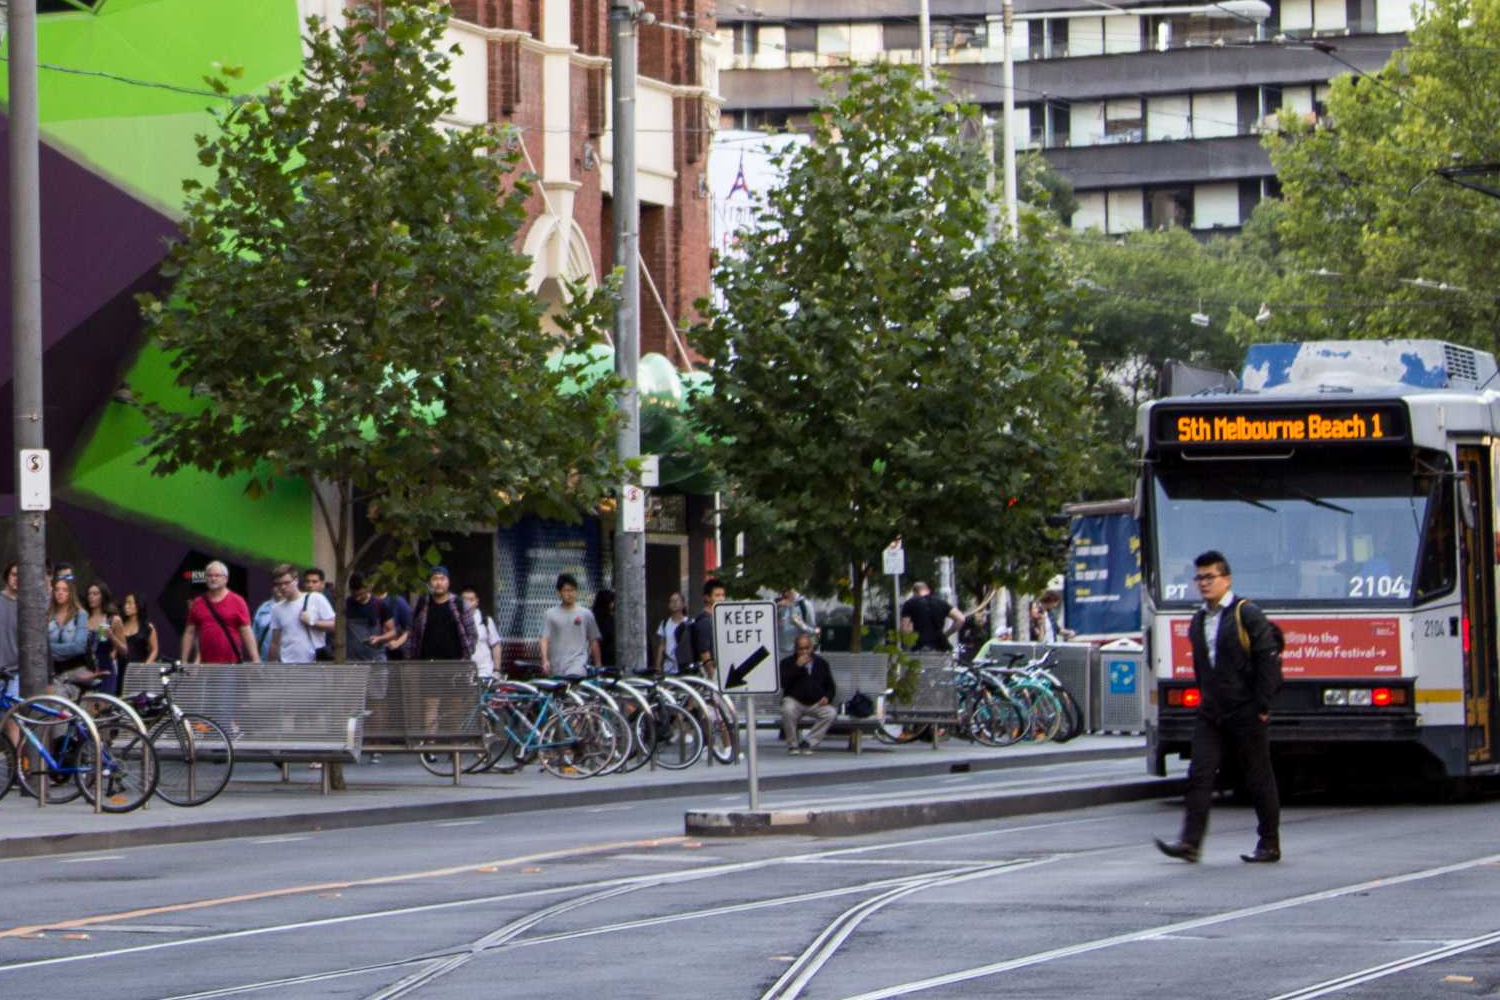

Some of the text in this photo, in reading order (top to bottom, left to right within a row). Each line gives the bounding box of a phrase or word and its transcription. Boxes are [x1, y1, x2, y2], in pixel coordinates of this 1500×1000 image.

[1178, 412, 1383, 441] Sth Melbourne Beach 1
[1349, 575, 1406, 597] 2104
[724, 611, 765, 625] KEEP
[1424, 619, 1445, 638] 2104
[726, 630, 763, 644] LEFT
[1308, 633, 1320, 644] to
[1321, 632, 1340, 644] the
[1304, 646, 1334, 658] Wine
[1334, 646, 1376, 659] Festival
